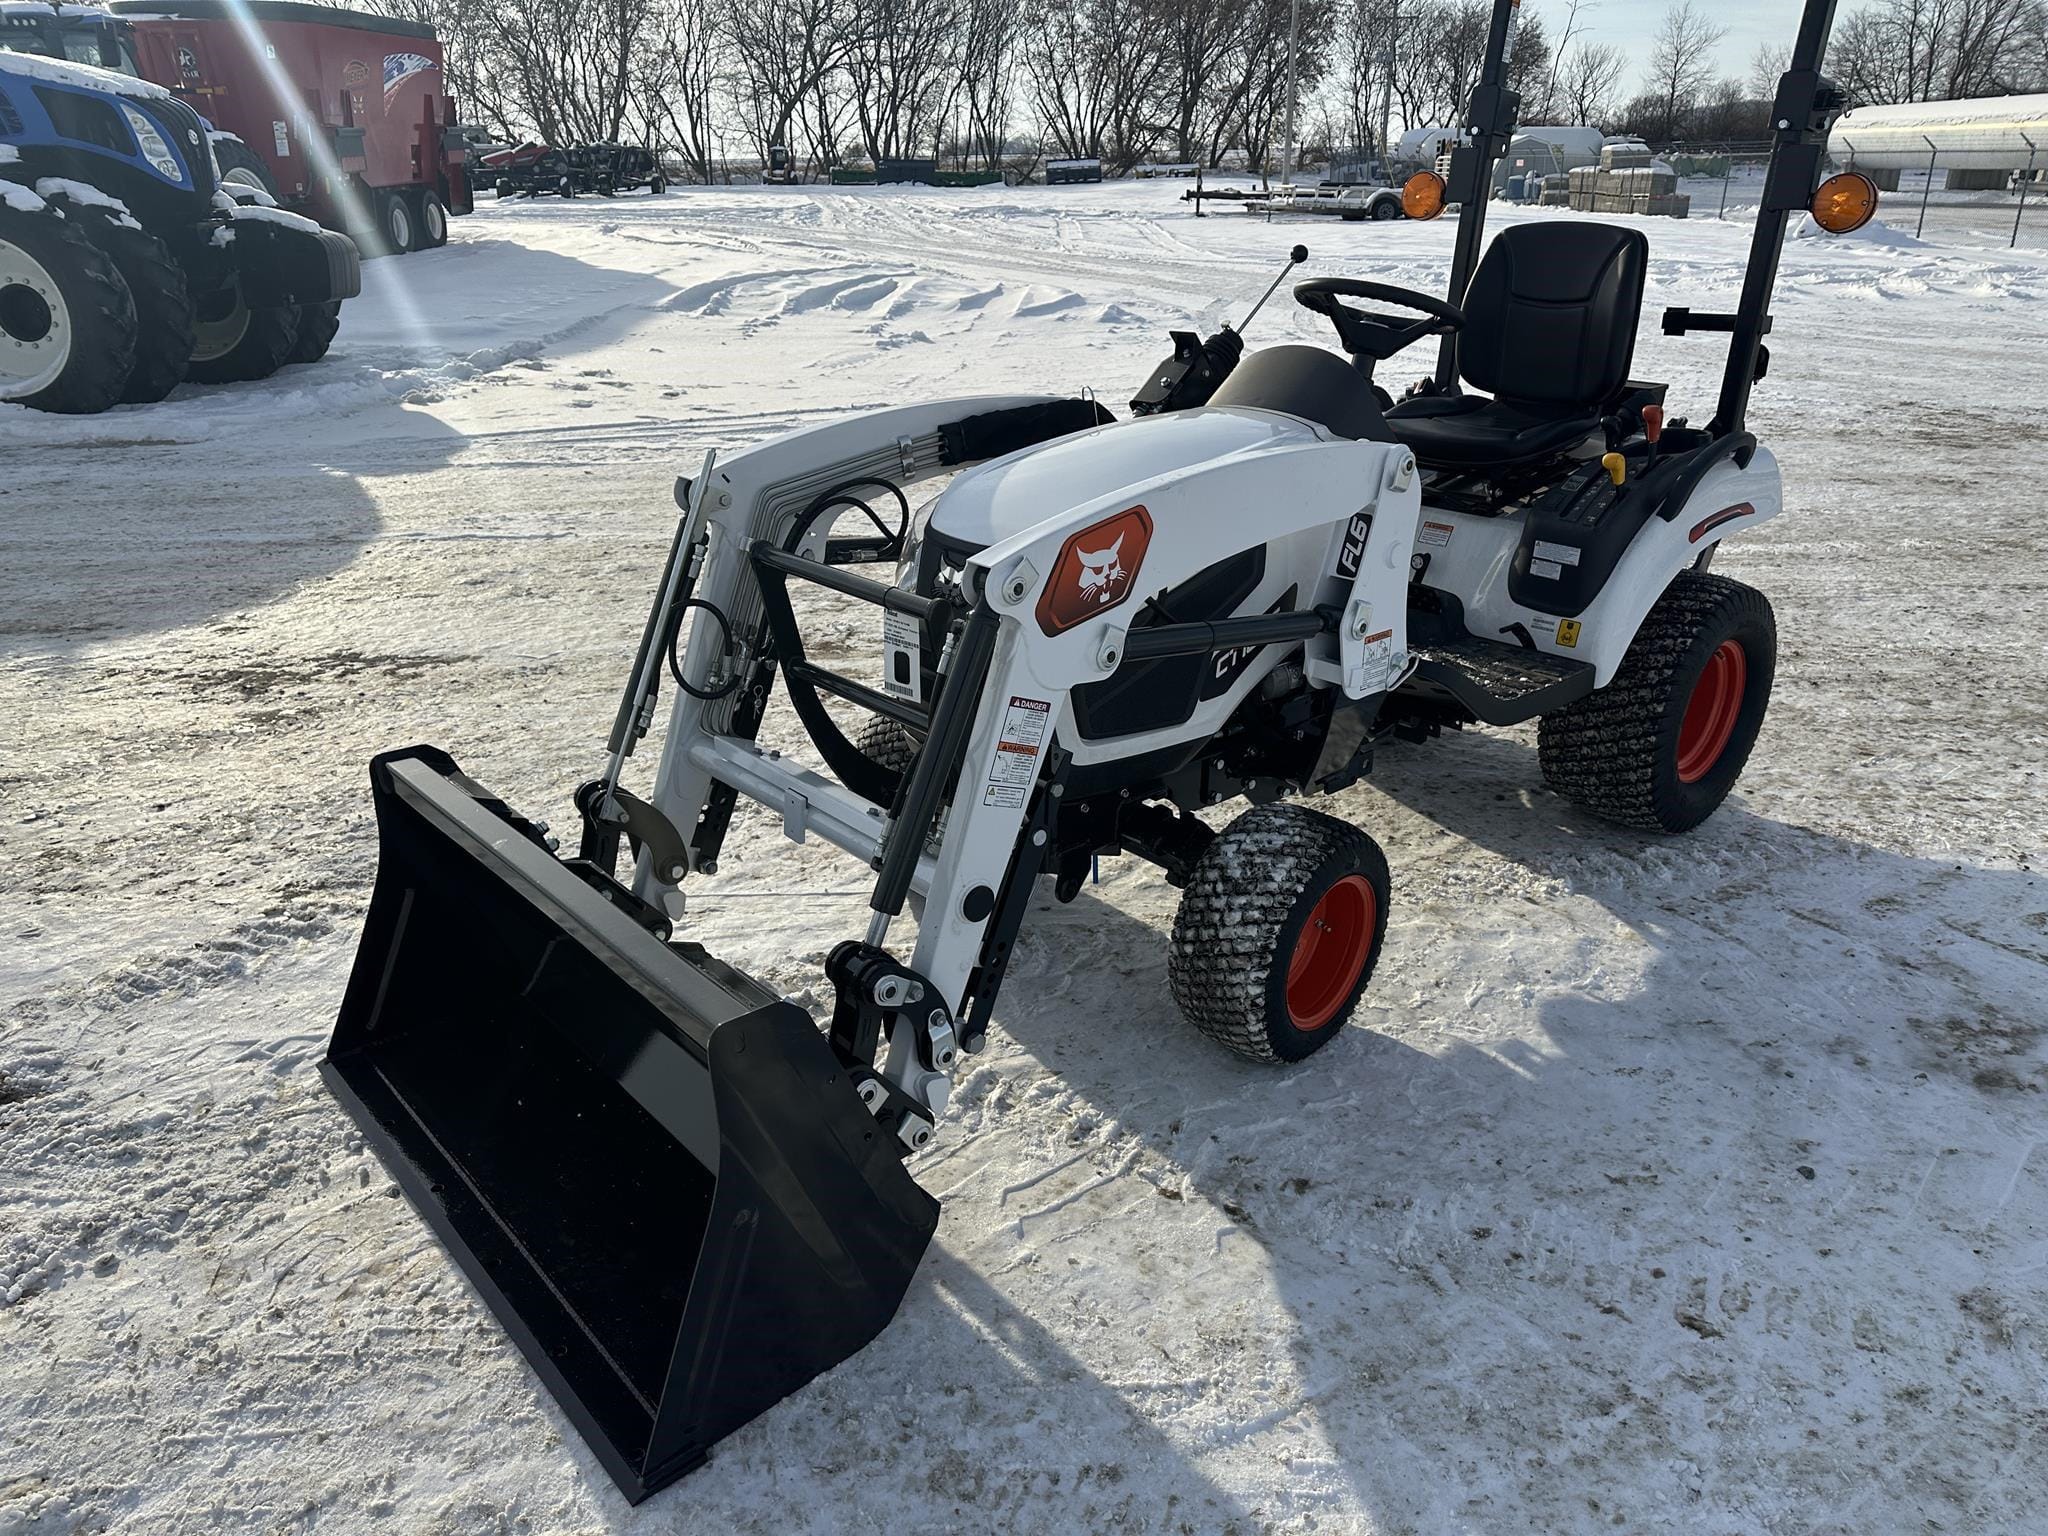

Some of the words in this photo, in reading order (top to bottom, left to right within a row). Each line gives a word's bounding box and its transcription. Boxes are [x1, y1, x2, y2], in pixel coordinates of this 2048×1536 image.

[1341, 516, 1368, 573] FL6
[1021, 700, 1047, 711] DANGER
[1007, 744, 1035, 754] WARNING
